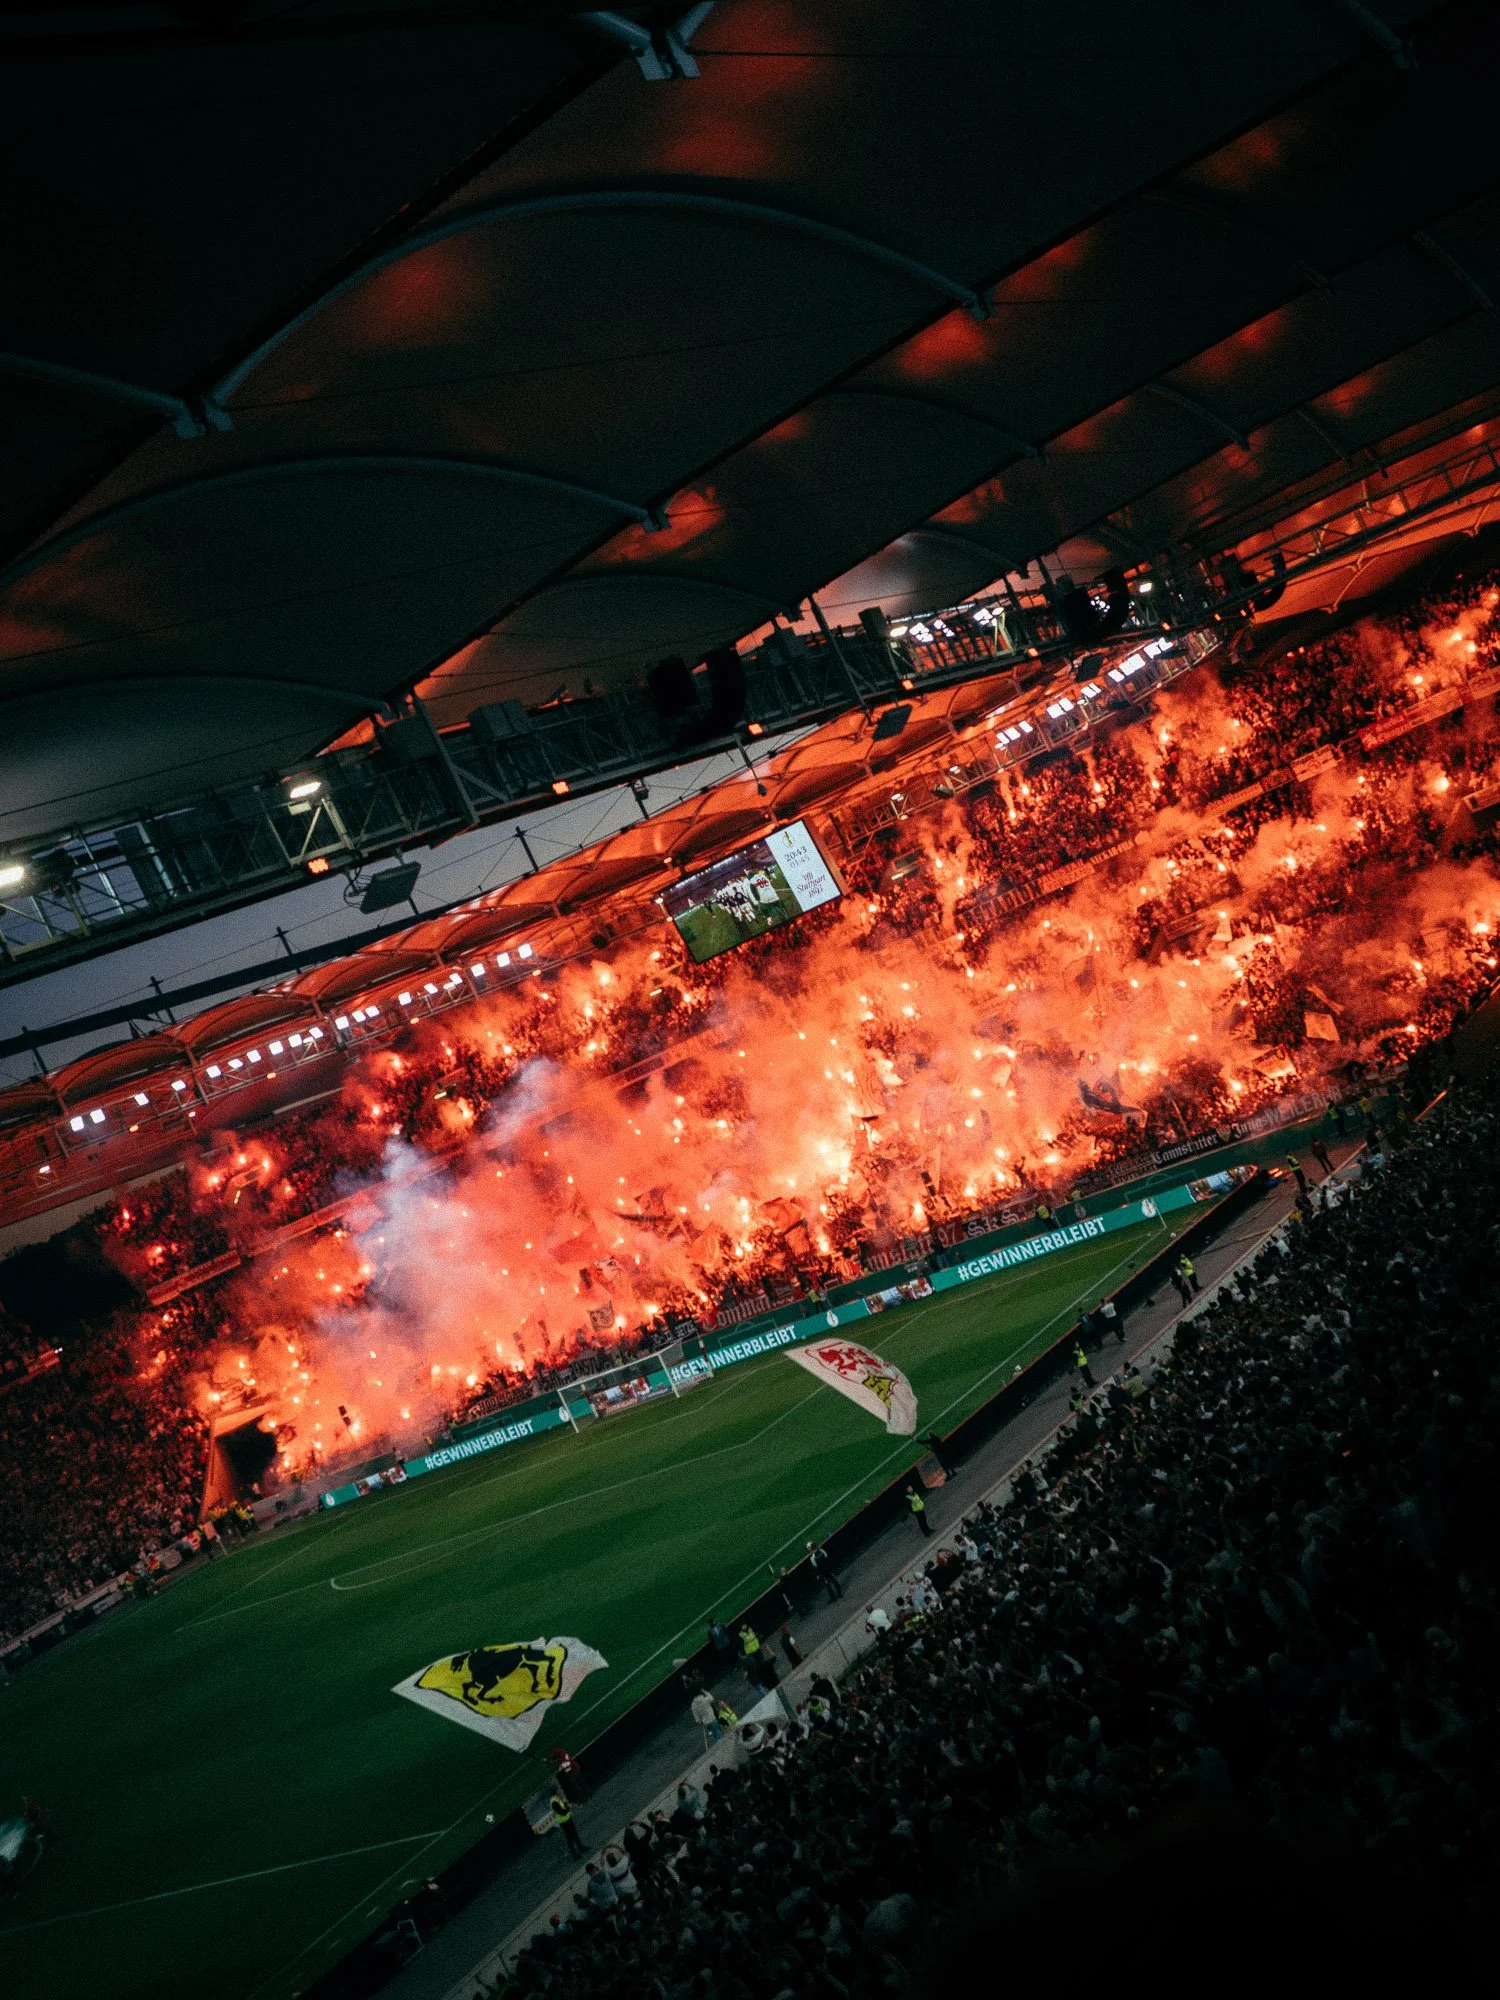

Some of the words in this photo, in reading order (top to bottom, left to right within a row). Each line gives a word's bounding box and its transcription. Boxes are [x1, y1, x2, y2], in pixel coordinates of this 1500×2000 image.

[784, 846, 807, 862] 20:43
[796, 874, 826, 892] Stuttgart
[957, 1217, 1106, 1281] #GEWINNERBLEIBT
[672, 1326, 797, 1381] #GEWINNERBLEIBT
[425, 1419, 533, 1470] #GEWINNERBLEIBT
